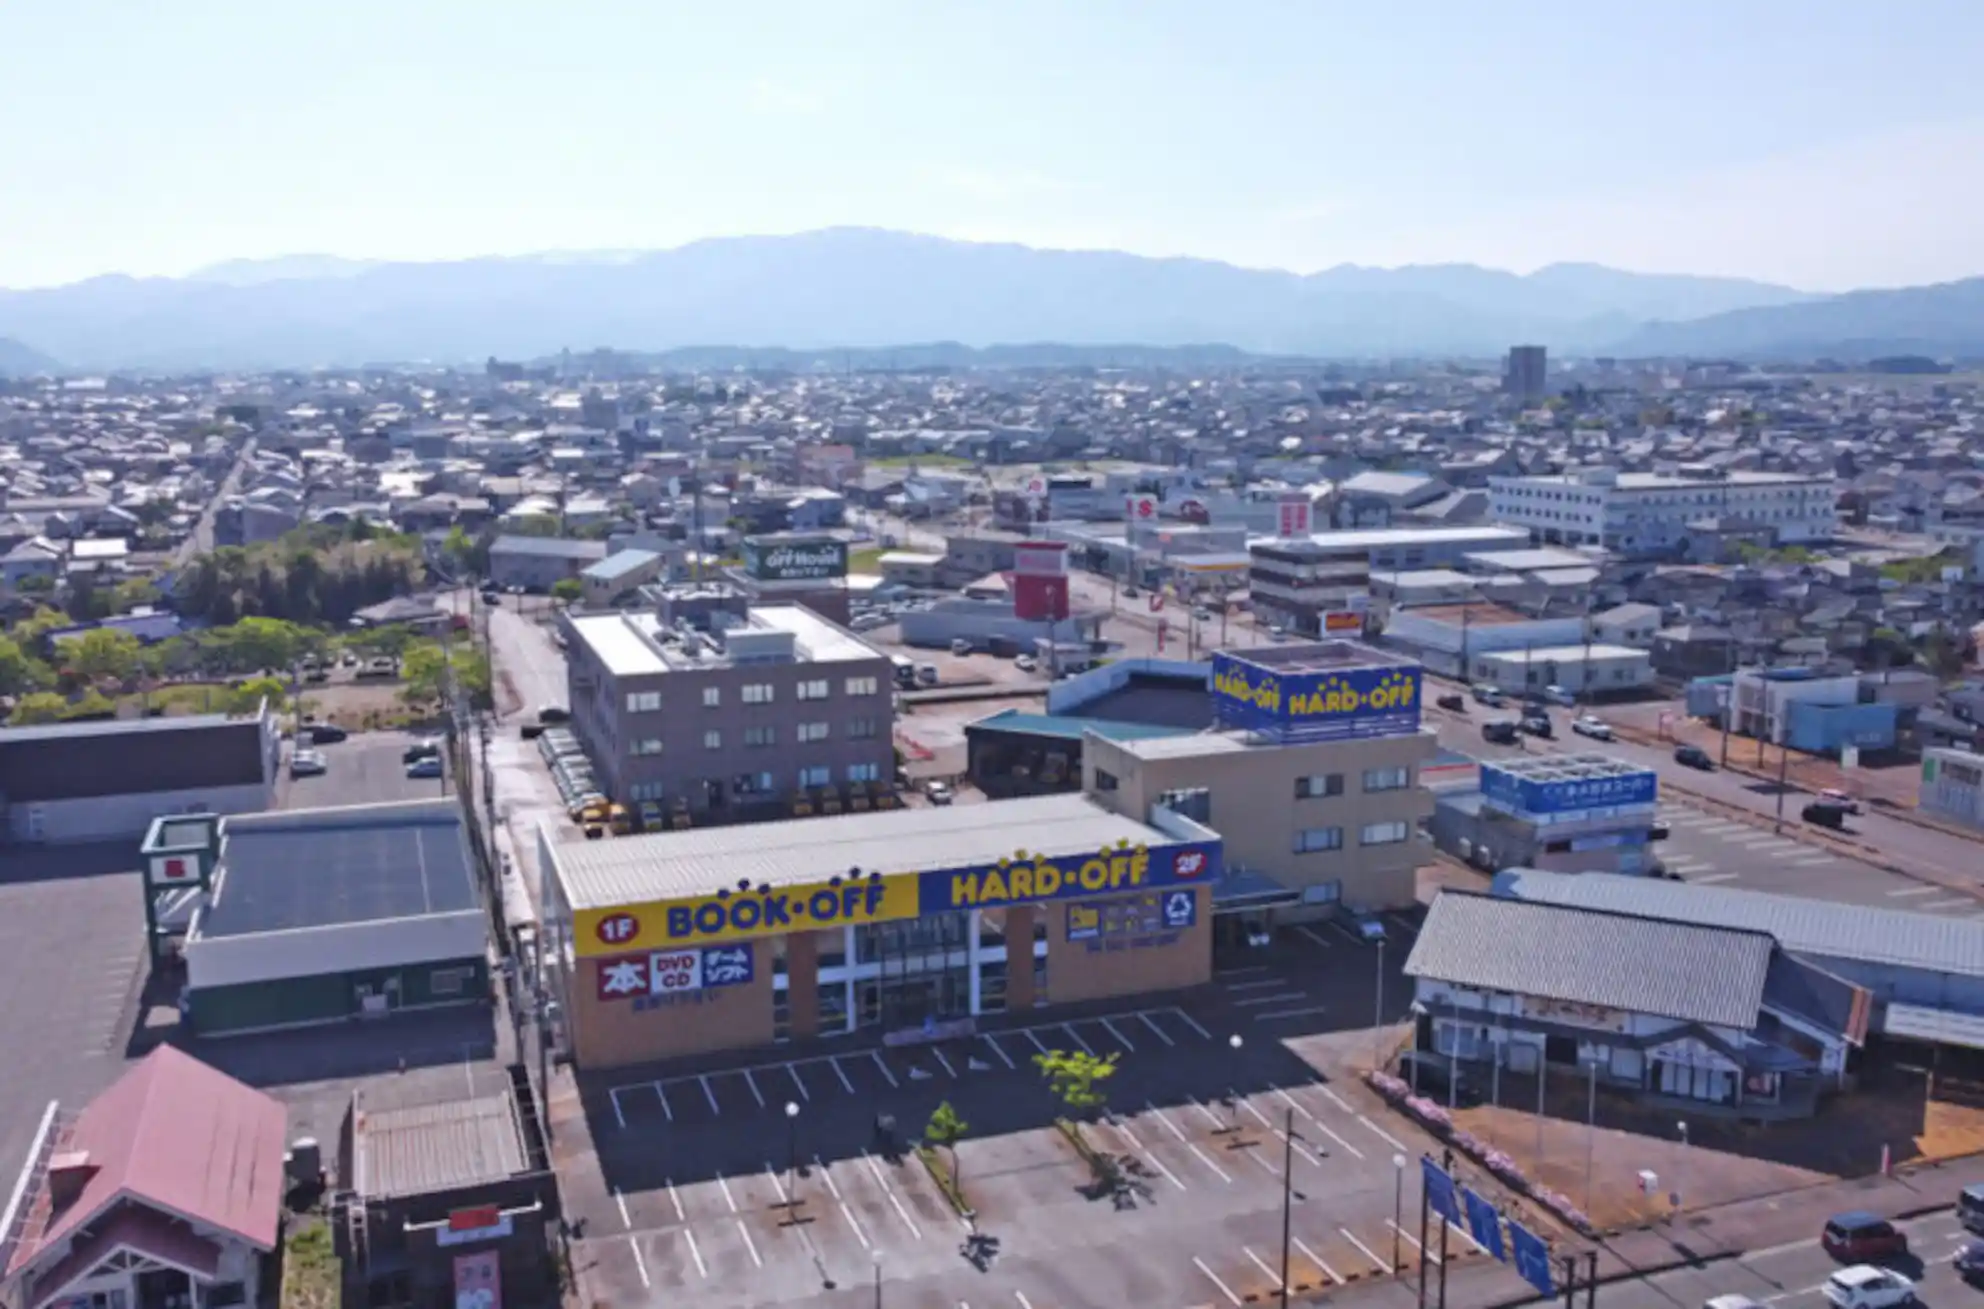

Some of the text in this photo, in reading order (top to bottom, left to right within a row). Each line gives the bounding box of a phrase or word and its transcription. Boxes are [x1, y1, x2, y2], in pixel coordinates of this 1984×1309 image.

[1175, 852, 1203, 874] 2F
[602, 917, 634, 939] 1F
[656, 955, 695, 973] DVD
[706, 965, 749, 982] ソフト
[602, 960, 647, 993] 本
[662, 972, 691, 988] CD
